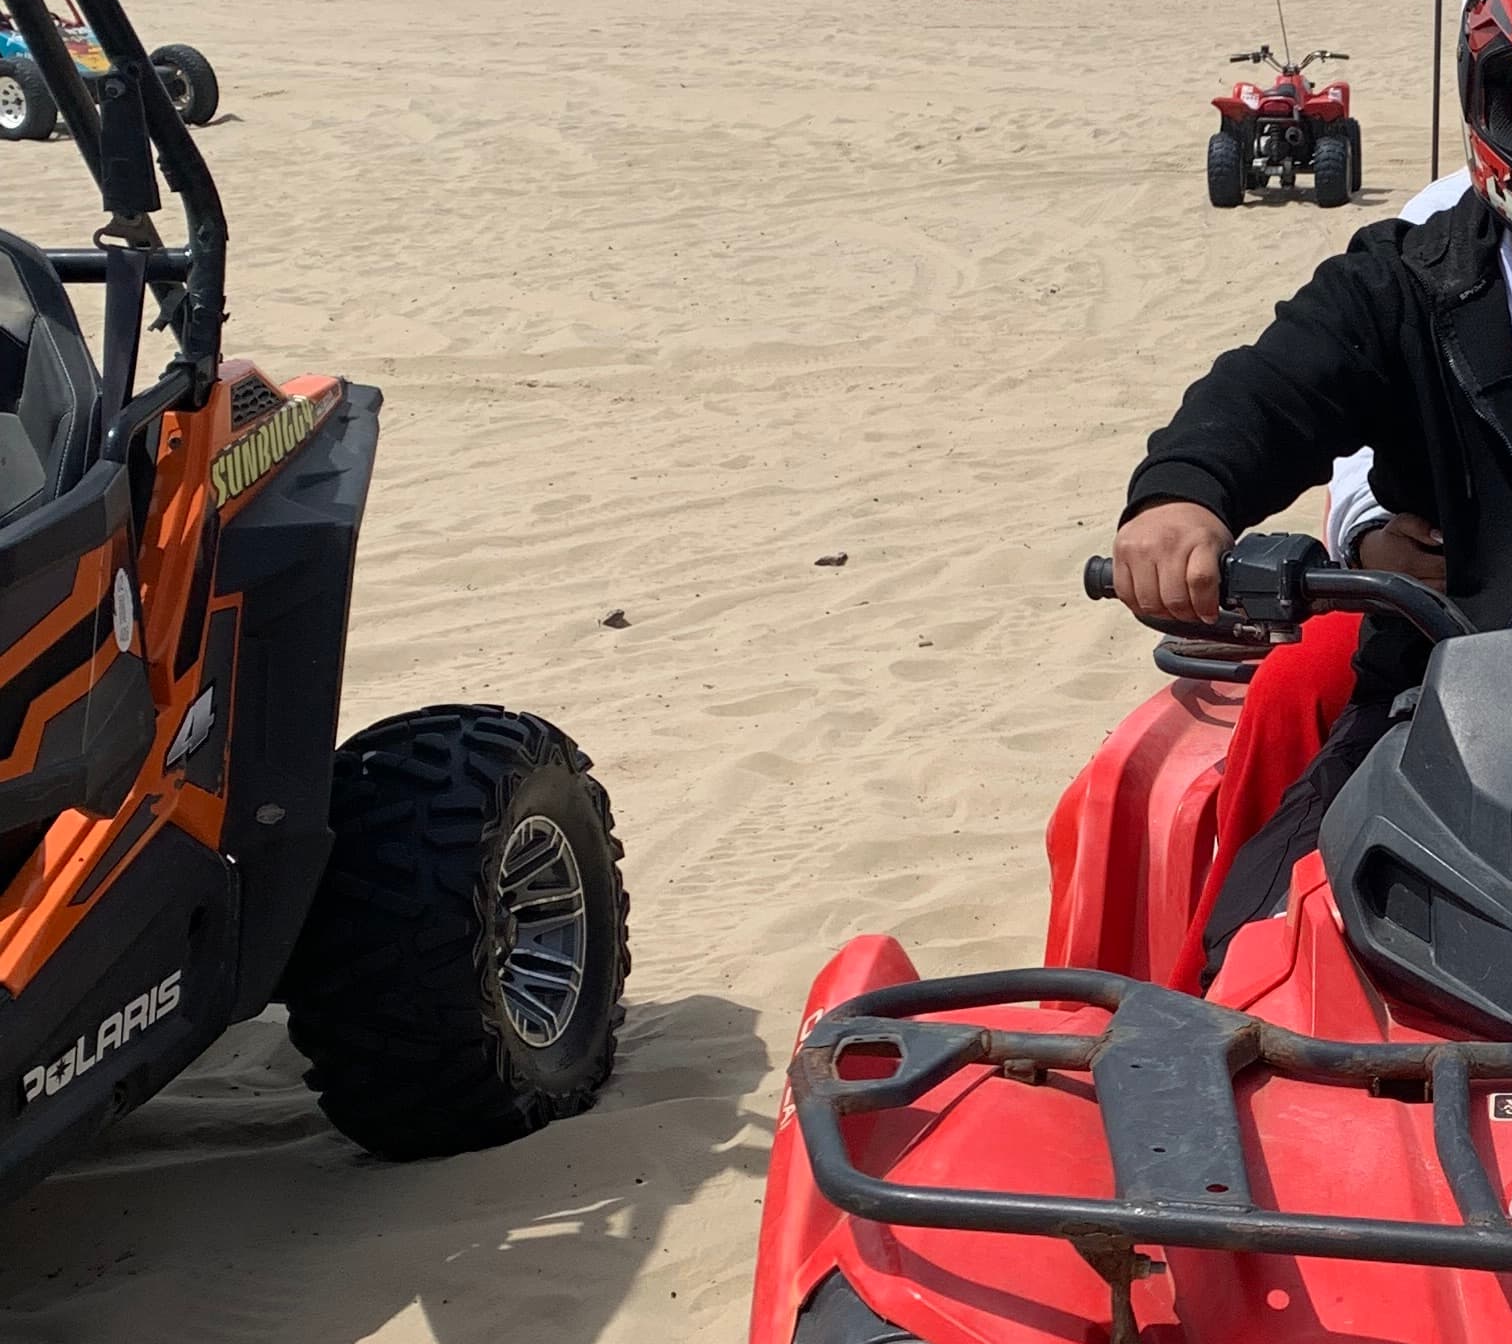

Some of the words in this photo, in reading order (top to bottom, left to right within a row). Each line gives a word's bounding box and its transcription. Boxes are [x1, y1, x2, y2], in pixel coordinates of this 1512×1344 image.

[212, 395, 314, 509] SUNBUGGY
[166, 685, 215, 767] 4
[23, 981, 182, 1104] POLARIS
